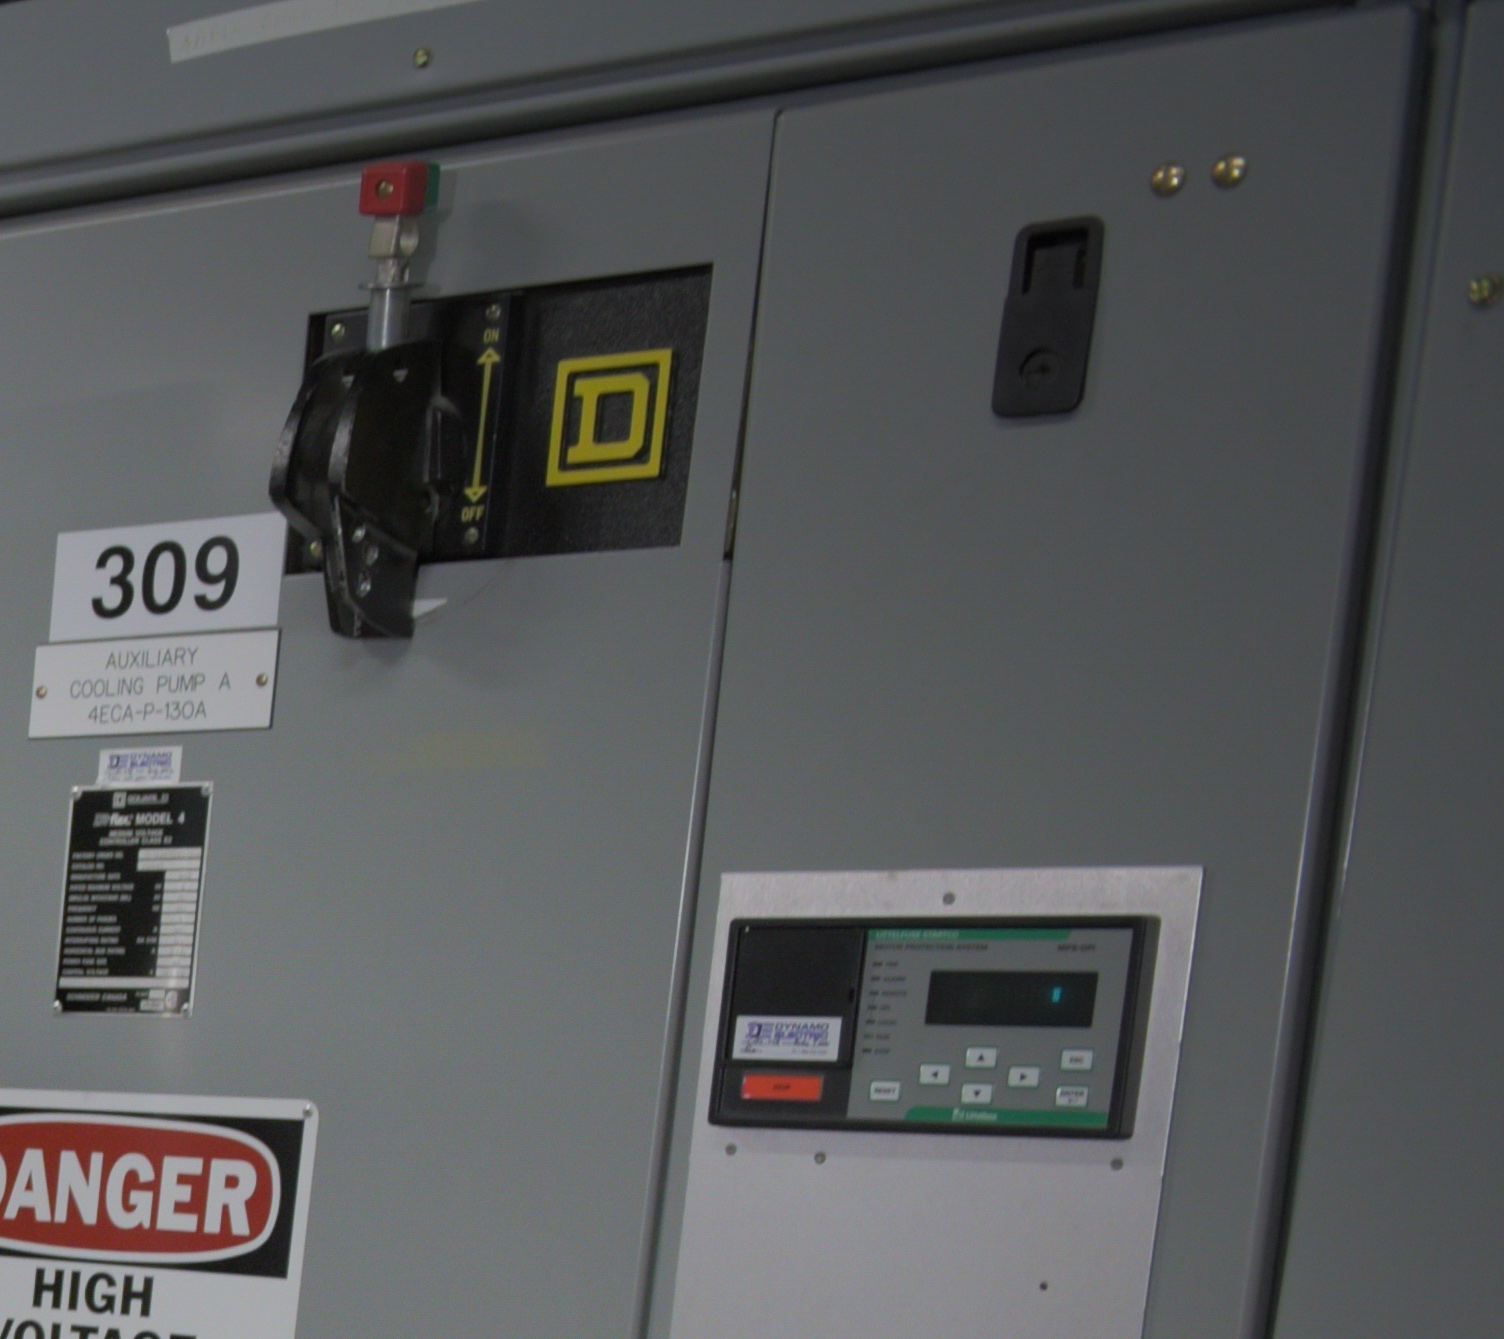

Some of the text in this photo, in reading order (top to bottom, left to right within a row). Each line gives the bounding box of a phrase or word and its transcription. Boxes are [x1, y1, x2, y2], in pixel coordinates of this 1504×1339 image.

[483, 328, 500, 344] ON
[461, 505, 485, 523] OFF
[91, 535, 240, 619] 309
[105, 647, 199, 670] AUXILIARY
[70, 671, 231, 699] COOLING PUMP A
[88, 700, 207, 724] 4ECA-P-130A
[136, 813, 174, 824] MODEL
[32, 1267, 155, 1318] HIGH
